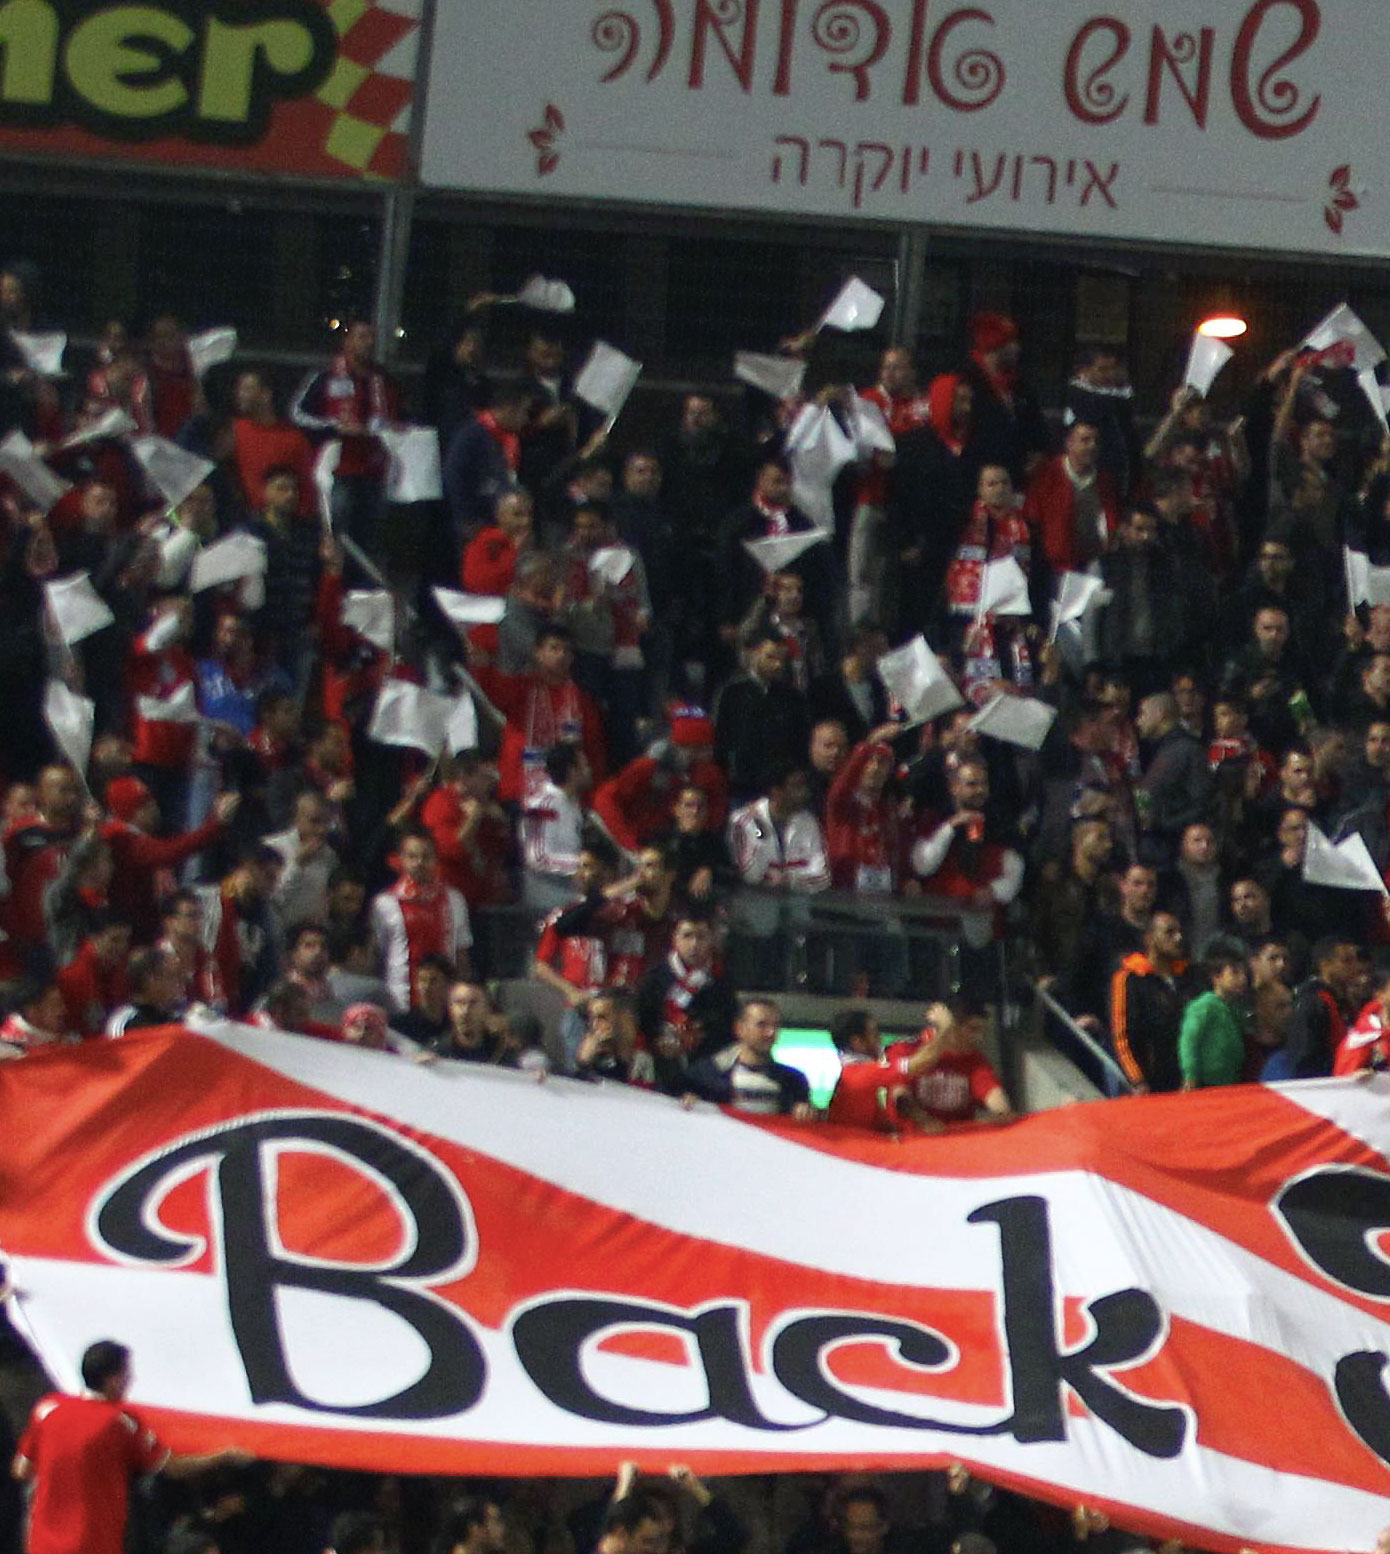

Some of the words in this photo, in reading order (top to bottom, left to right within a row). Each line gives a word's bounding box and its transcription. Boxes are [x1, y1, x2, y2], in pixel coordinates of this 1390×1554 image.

[770, 134, 928, 206] יוקרה
[953, 153, 1119, 209] אירועי
[96, 1113, 1188, 1458] Back
